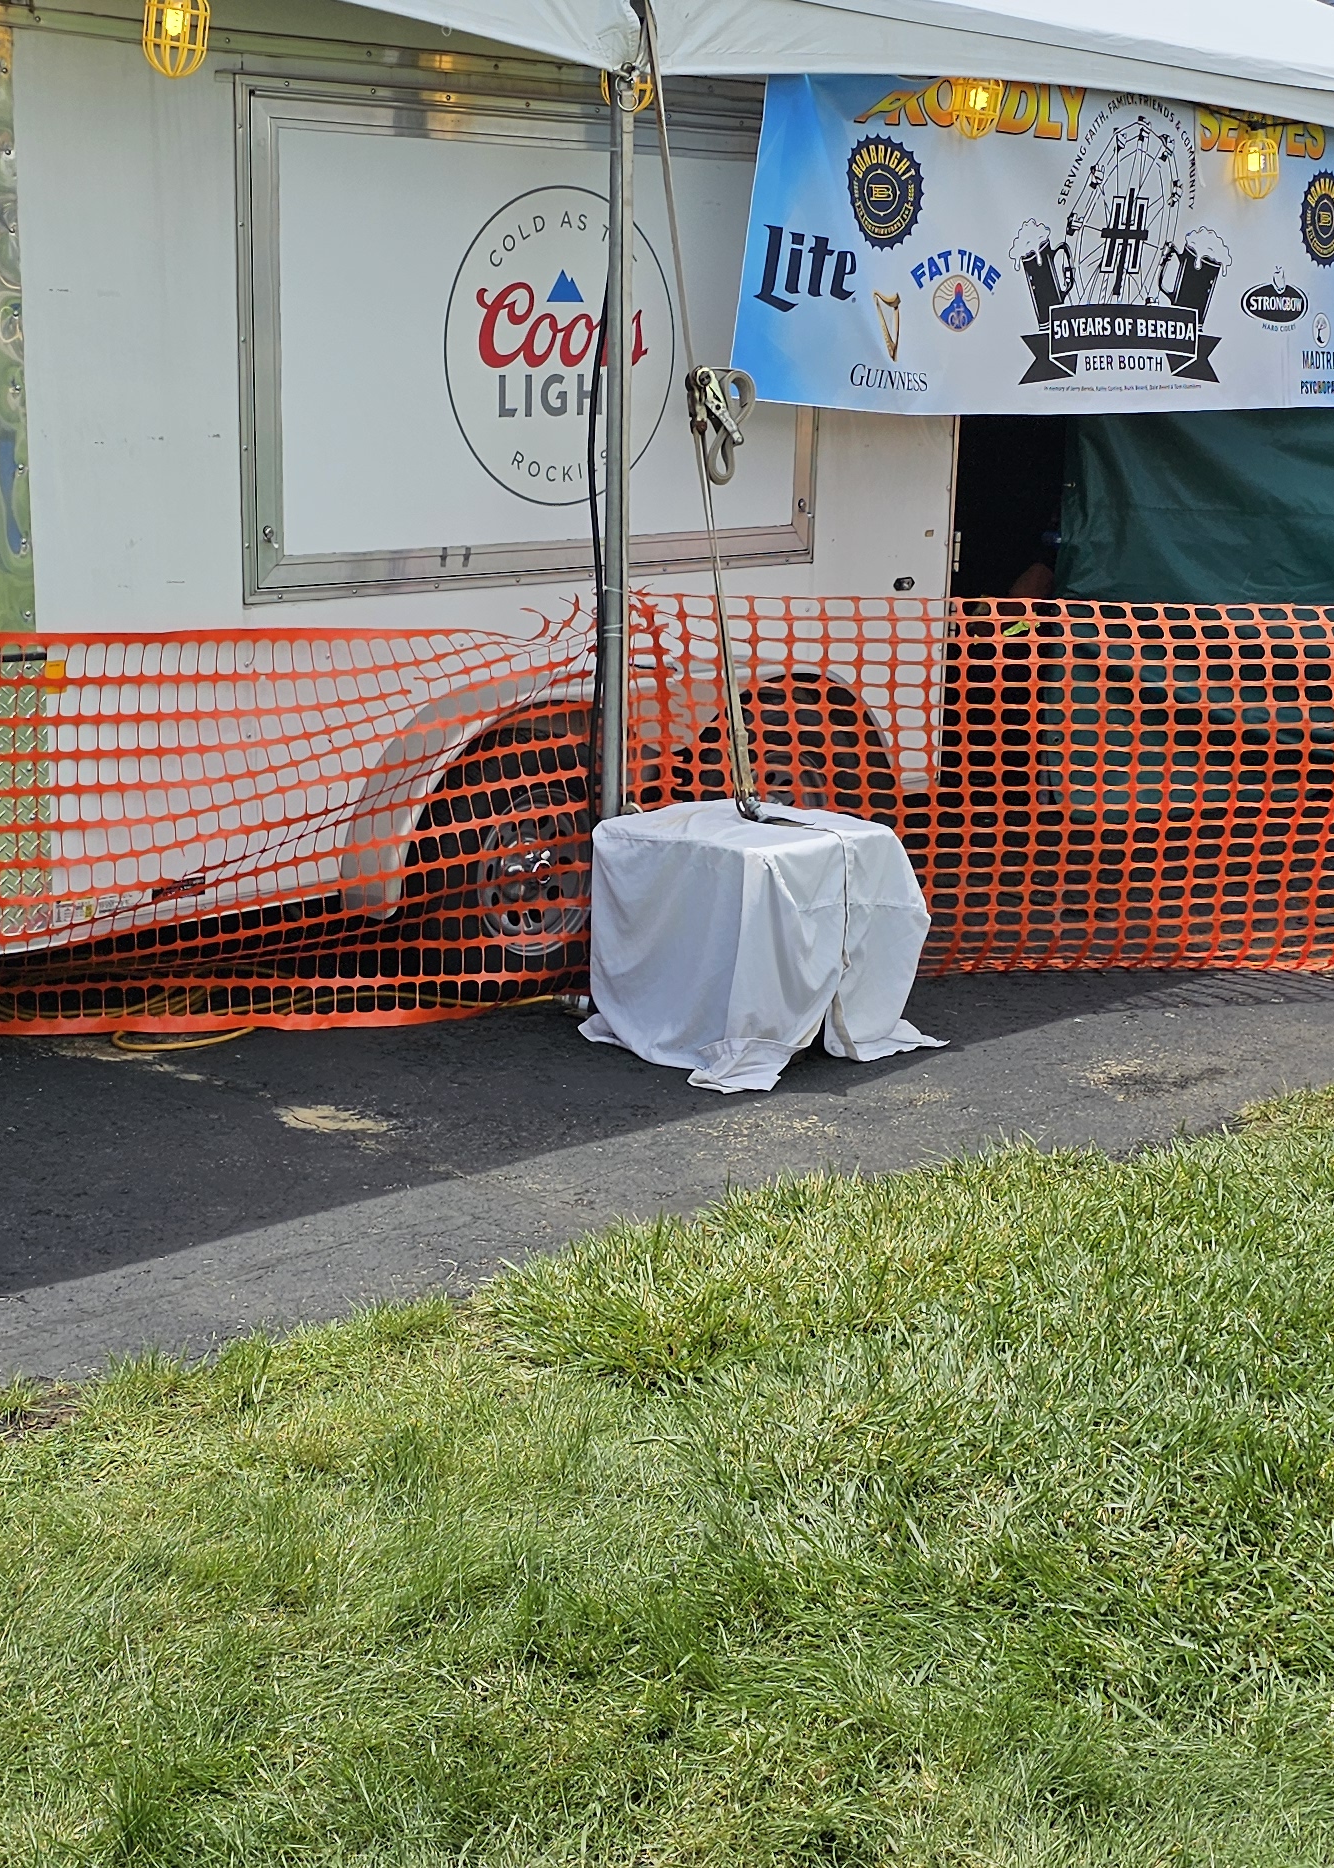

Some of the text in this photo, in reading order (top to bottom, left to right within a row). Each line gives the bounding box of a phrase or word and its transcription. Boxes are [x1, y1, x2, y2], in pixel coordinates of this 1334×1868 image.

[854, 76, 1087, 141] PRODLY
[1058, 94, 1196, 210] SERVING FAITH, FAMILY, FRIENDS & COMMUNITY
[489, 210, 588, 268] COLD AS
[753, 224, 857, 313] Lite
[910, 249, 1002, 291] FAT TIRE
[476, 281, 649, 368] Coos
[1249, 296, 1302, 312] STRONGBOW
[1053, 317, 1195, 341] 50 YEARS OF BEREDA
[849, 363, 929, 391] GUINNESS
[1084, 355, 1163, 372] BEER BOOTH
[498, 373, 604, 417] LIGH
[511, 450, 608, 482] ROCKIS
